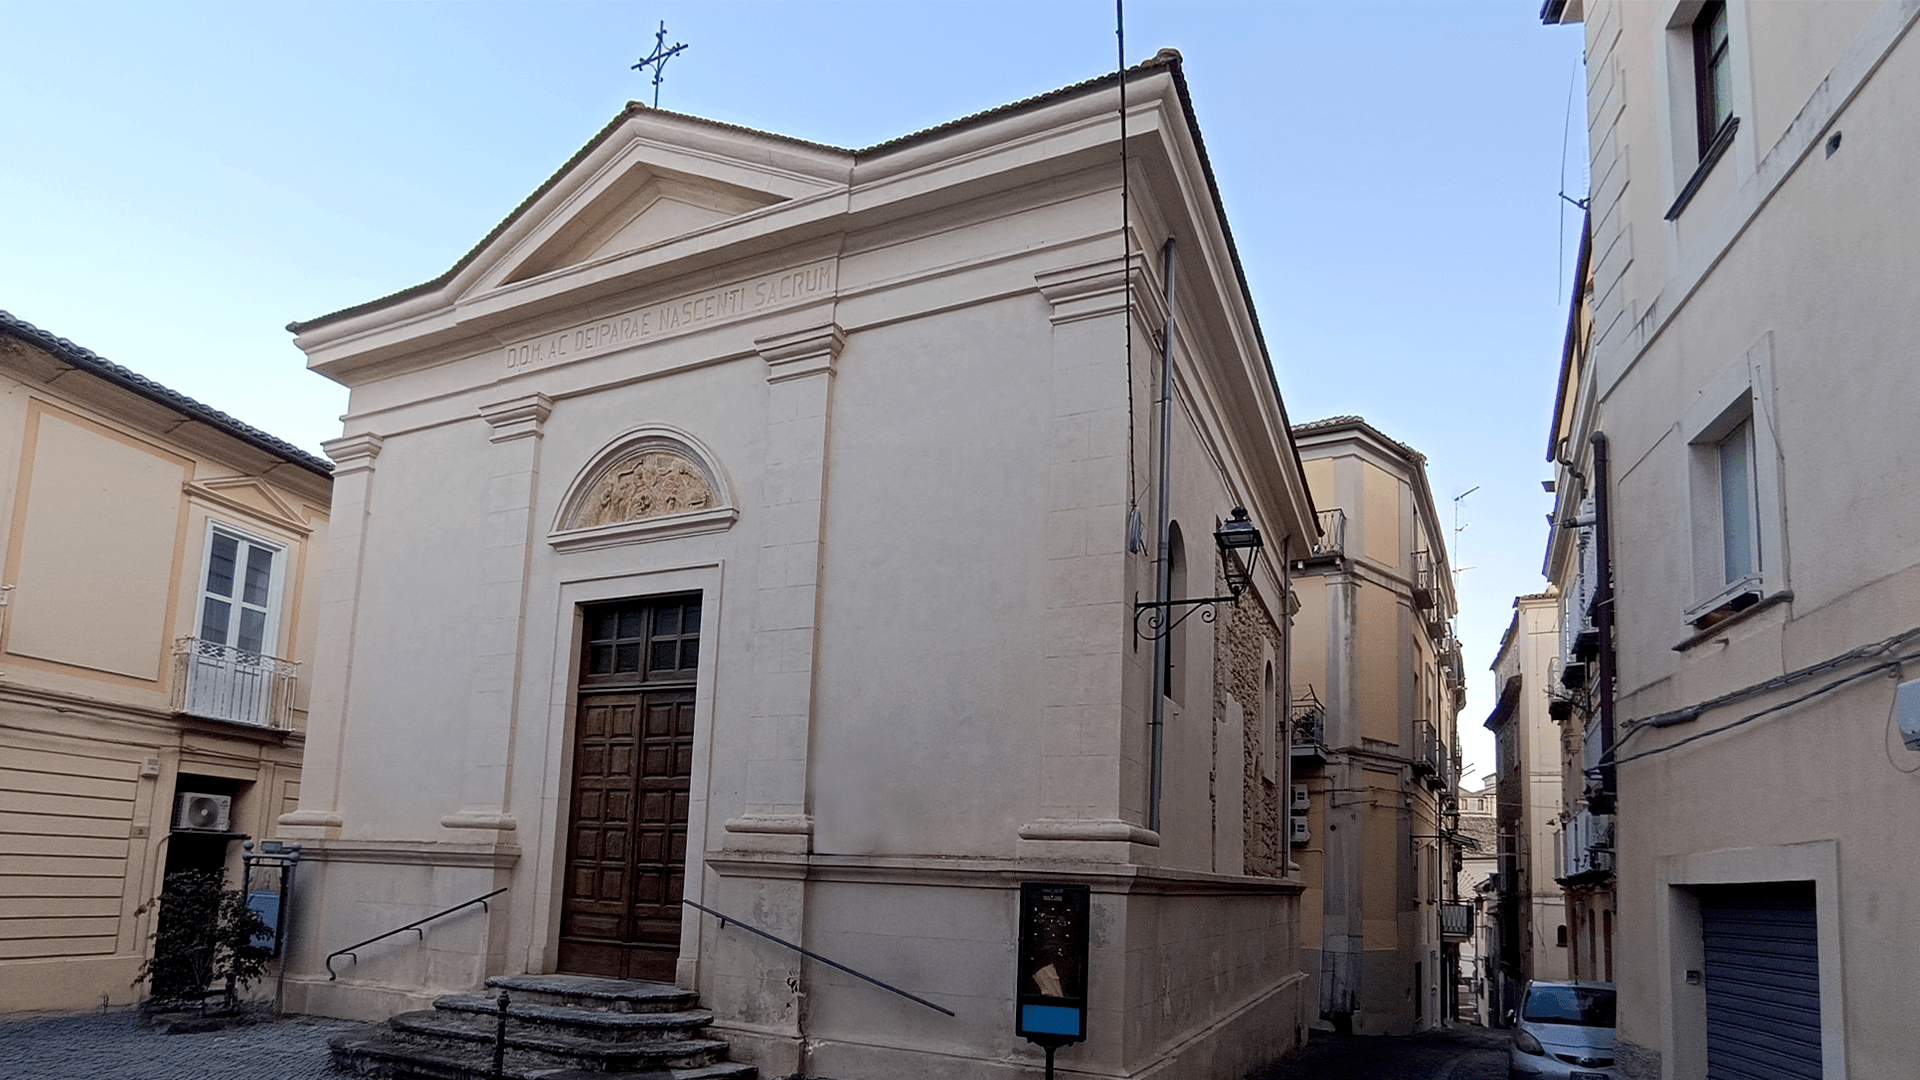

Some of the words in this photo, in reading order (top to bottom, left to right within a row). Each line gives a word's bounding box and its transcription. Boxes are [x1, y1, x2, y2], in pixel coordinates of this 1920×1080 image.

[548, 334, 568, 360] AC
[575, 313, 652, 352] DEIPARAE
[659, 287, 745, 331] NASCENTI
[754, 264, 831, 307] SACRUM
